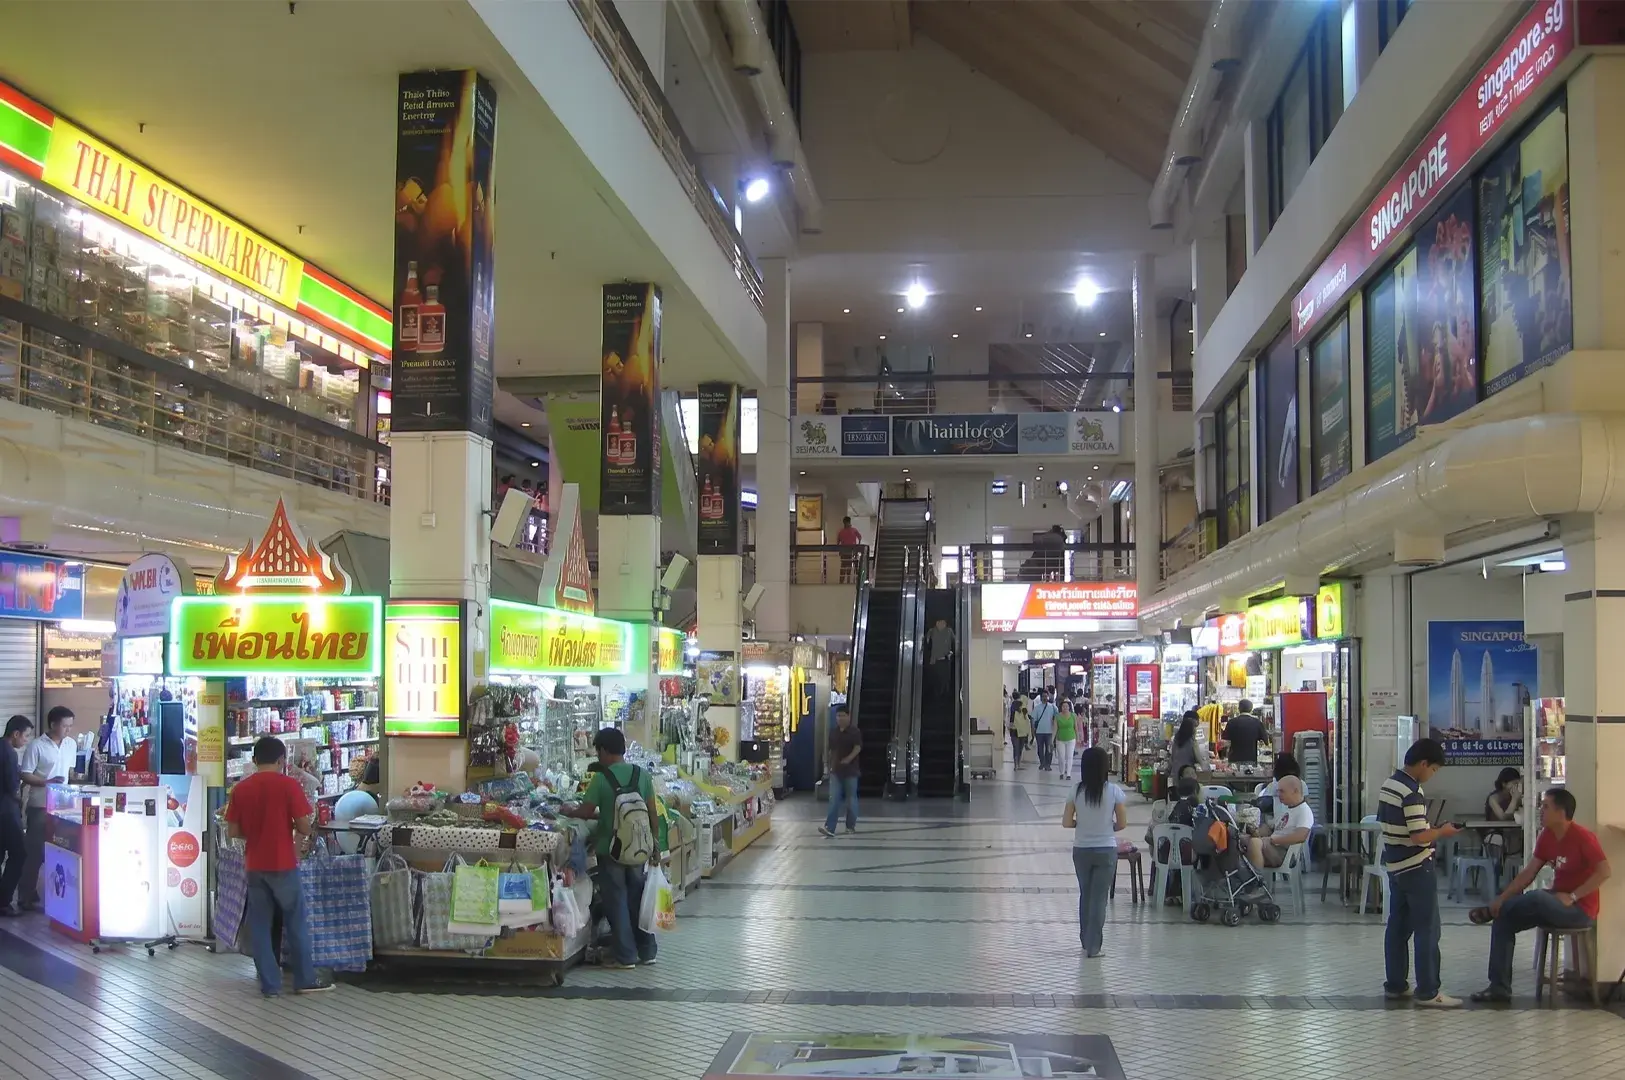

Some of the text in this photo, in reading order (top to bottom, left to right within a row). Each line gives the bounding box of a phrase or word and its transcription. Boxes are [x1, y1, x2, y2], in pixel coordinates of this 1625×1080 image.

[1478, 0, 1564, 109] singapore.sg
[72, 139, 289, 296] THAI SUPERMARKET
[1371, 132, 1448, 250] SINGAPORE
[191, 607, 369, 661] เพื่อนไทย
